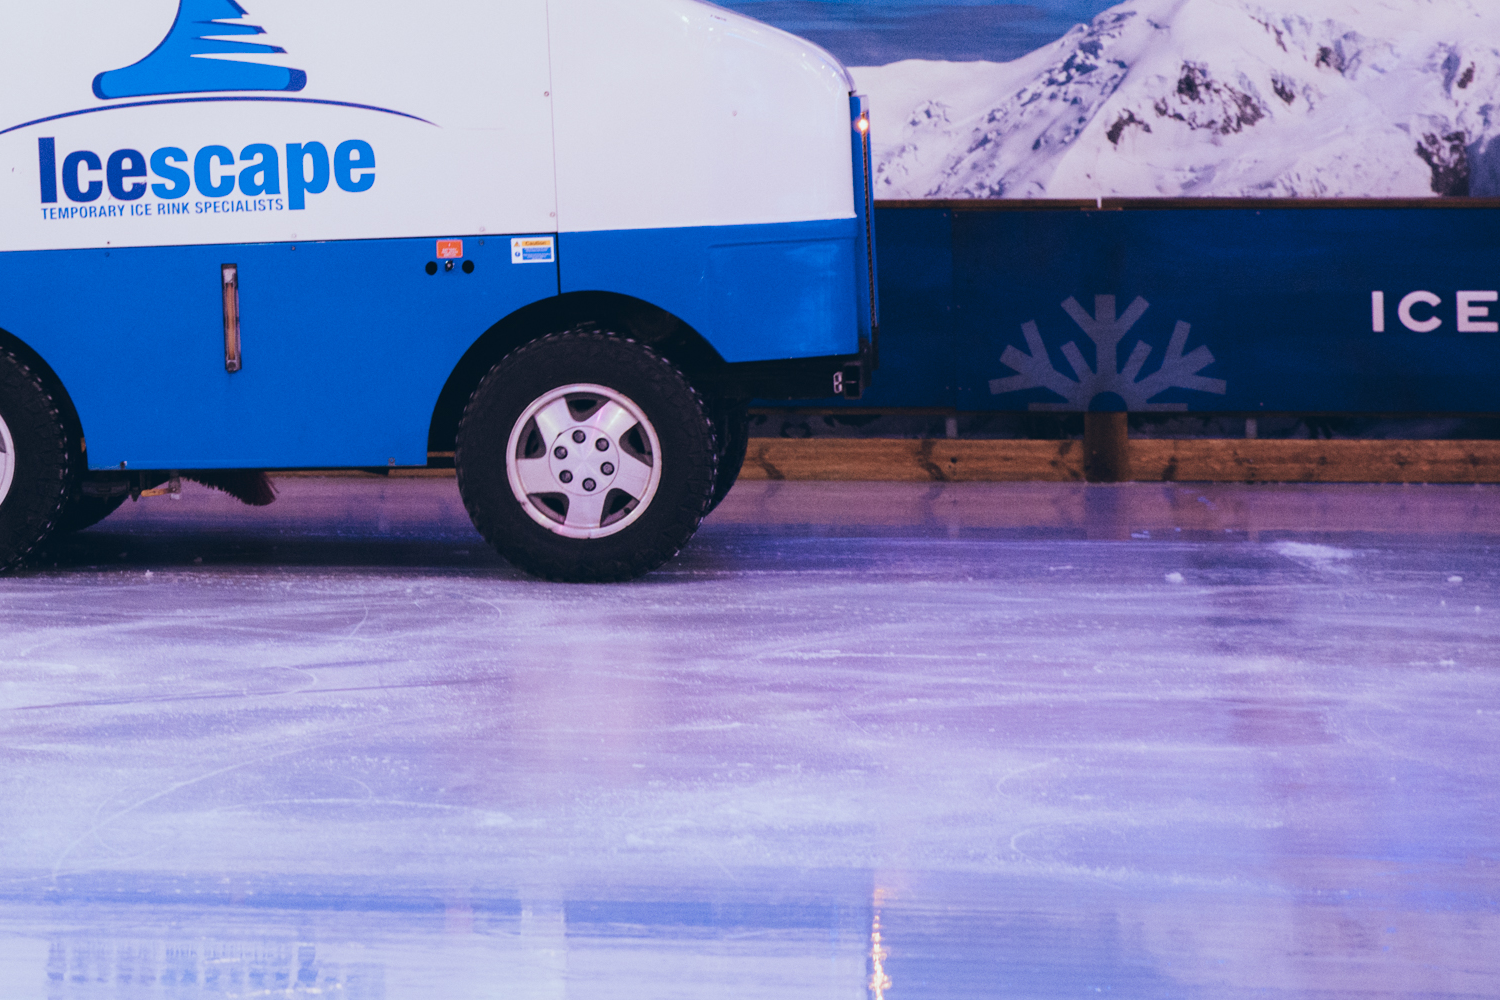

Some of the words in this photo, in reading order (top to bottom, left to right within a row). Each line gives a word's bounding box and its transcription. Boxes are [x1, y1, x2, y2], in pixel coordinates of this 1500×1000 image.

[38, 137, 376, 210] Icescape
[41, 204, 125, 220] TEMPORARY
[131, 203, 152, 217] ICE
[157, 202, 190, 215] RINK
[195, 198, 283, 214] SPECIALISTS
[1371, 290, 1499, 333] ICE
